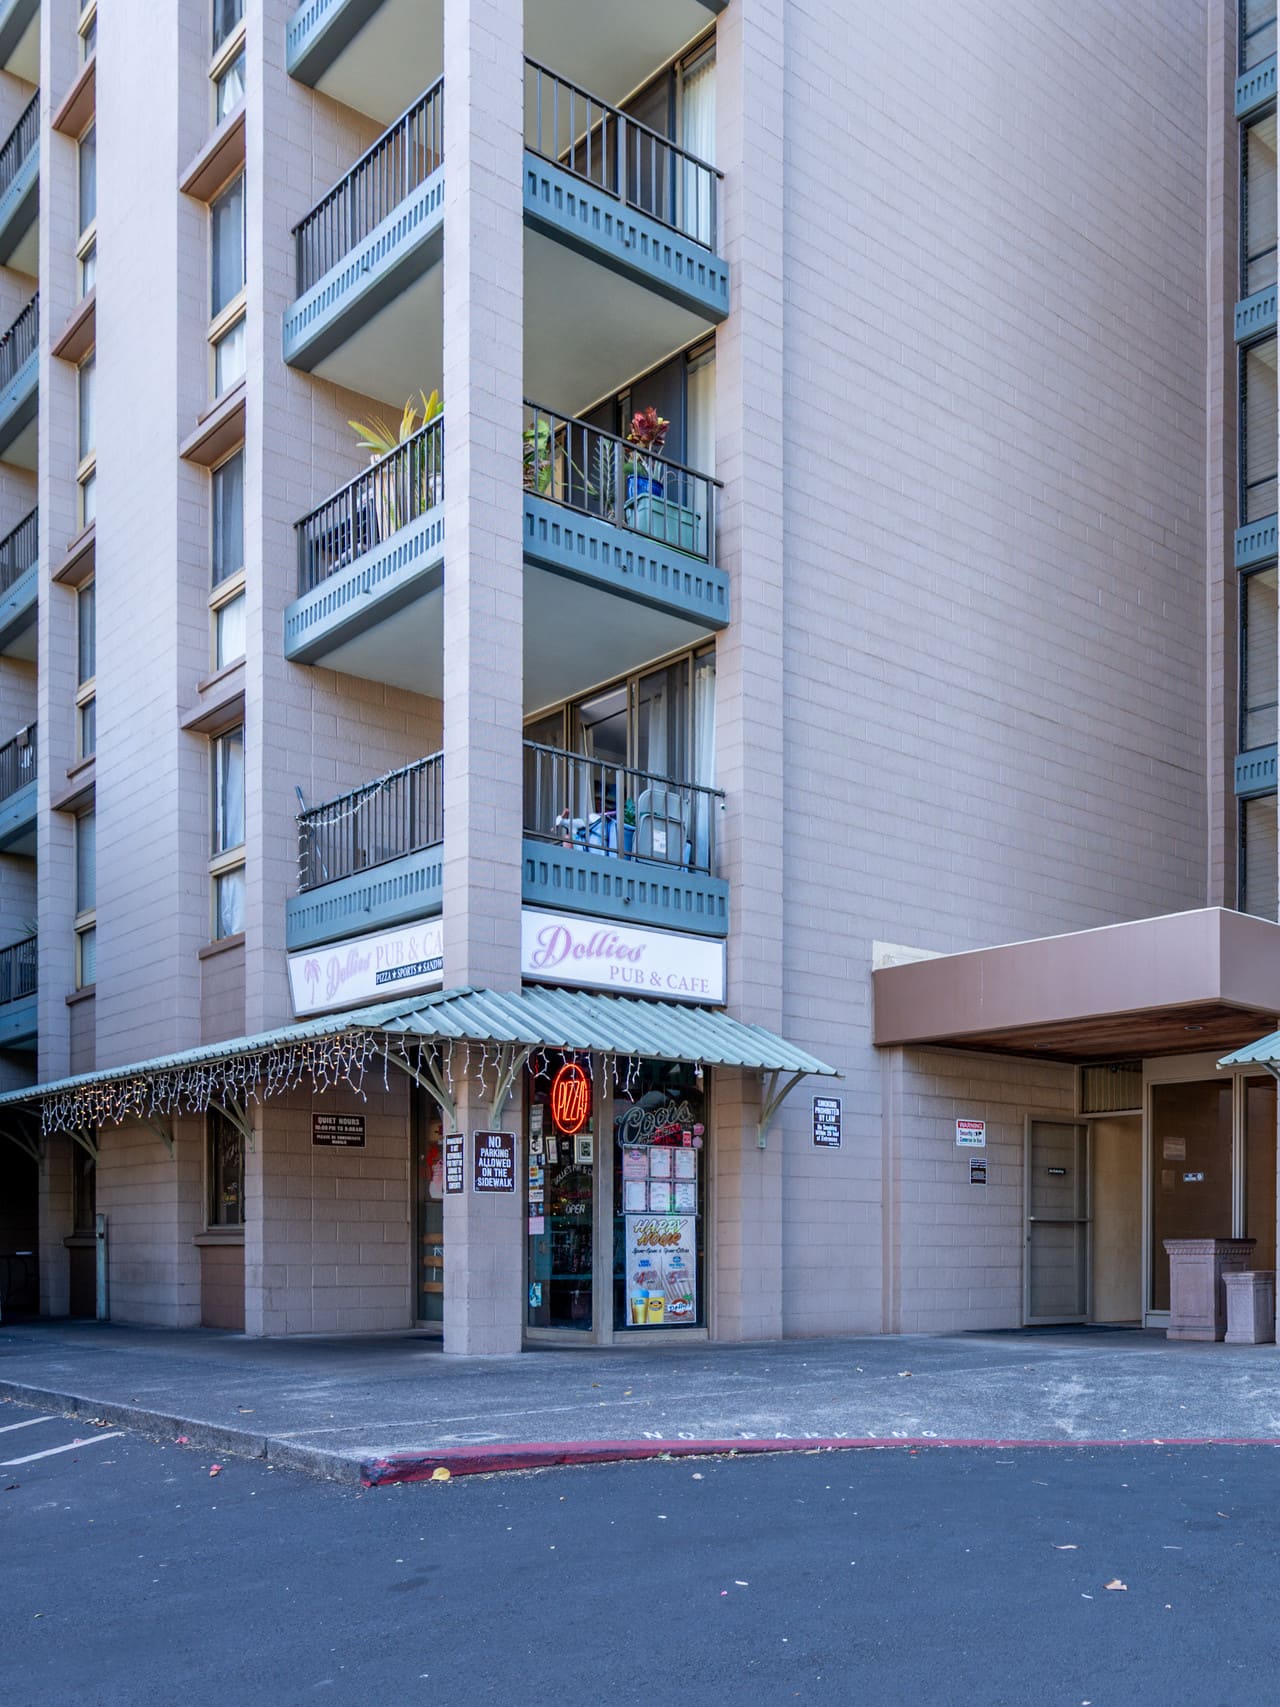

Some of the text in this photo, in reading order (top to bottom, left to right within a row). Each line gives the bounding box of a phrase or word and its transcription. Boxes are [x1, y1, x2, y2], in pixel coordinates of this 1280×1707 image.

[376, 940, 405, 969] PUB
[408, 936, 418, 960] &
[529, 923, 647, 970] Dollies
[326, 948, 373, 1000] Dollies
[376, 972, 391, 984] PIZZA
[397, 965, 417, 979] SPORTS
[610, 965, 710, 994] PUB & CAFE
[557, 1081, 585, 1121] PIZZA
[317, 1116, 360, 1126] QUIET HOURS
[959, 1121, 983, 1129] WARNING
[488, 1136, 501, 1148] NO
[480, 1147, 509, 1158] PARKING
[478, 1158, 511, 1168] ALLOWED
[482, 1167, 508, 1177] ON THE
[477, 1176, 513, 1187] SIDEWALK
[633, 1218, 688, 1234] HAPPY
[636, 1232, 682, 1247] HOUR
